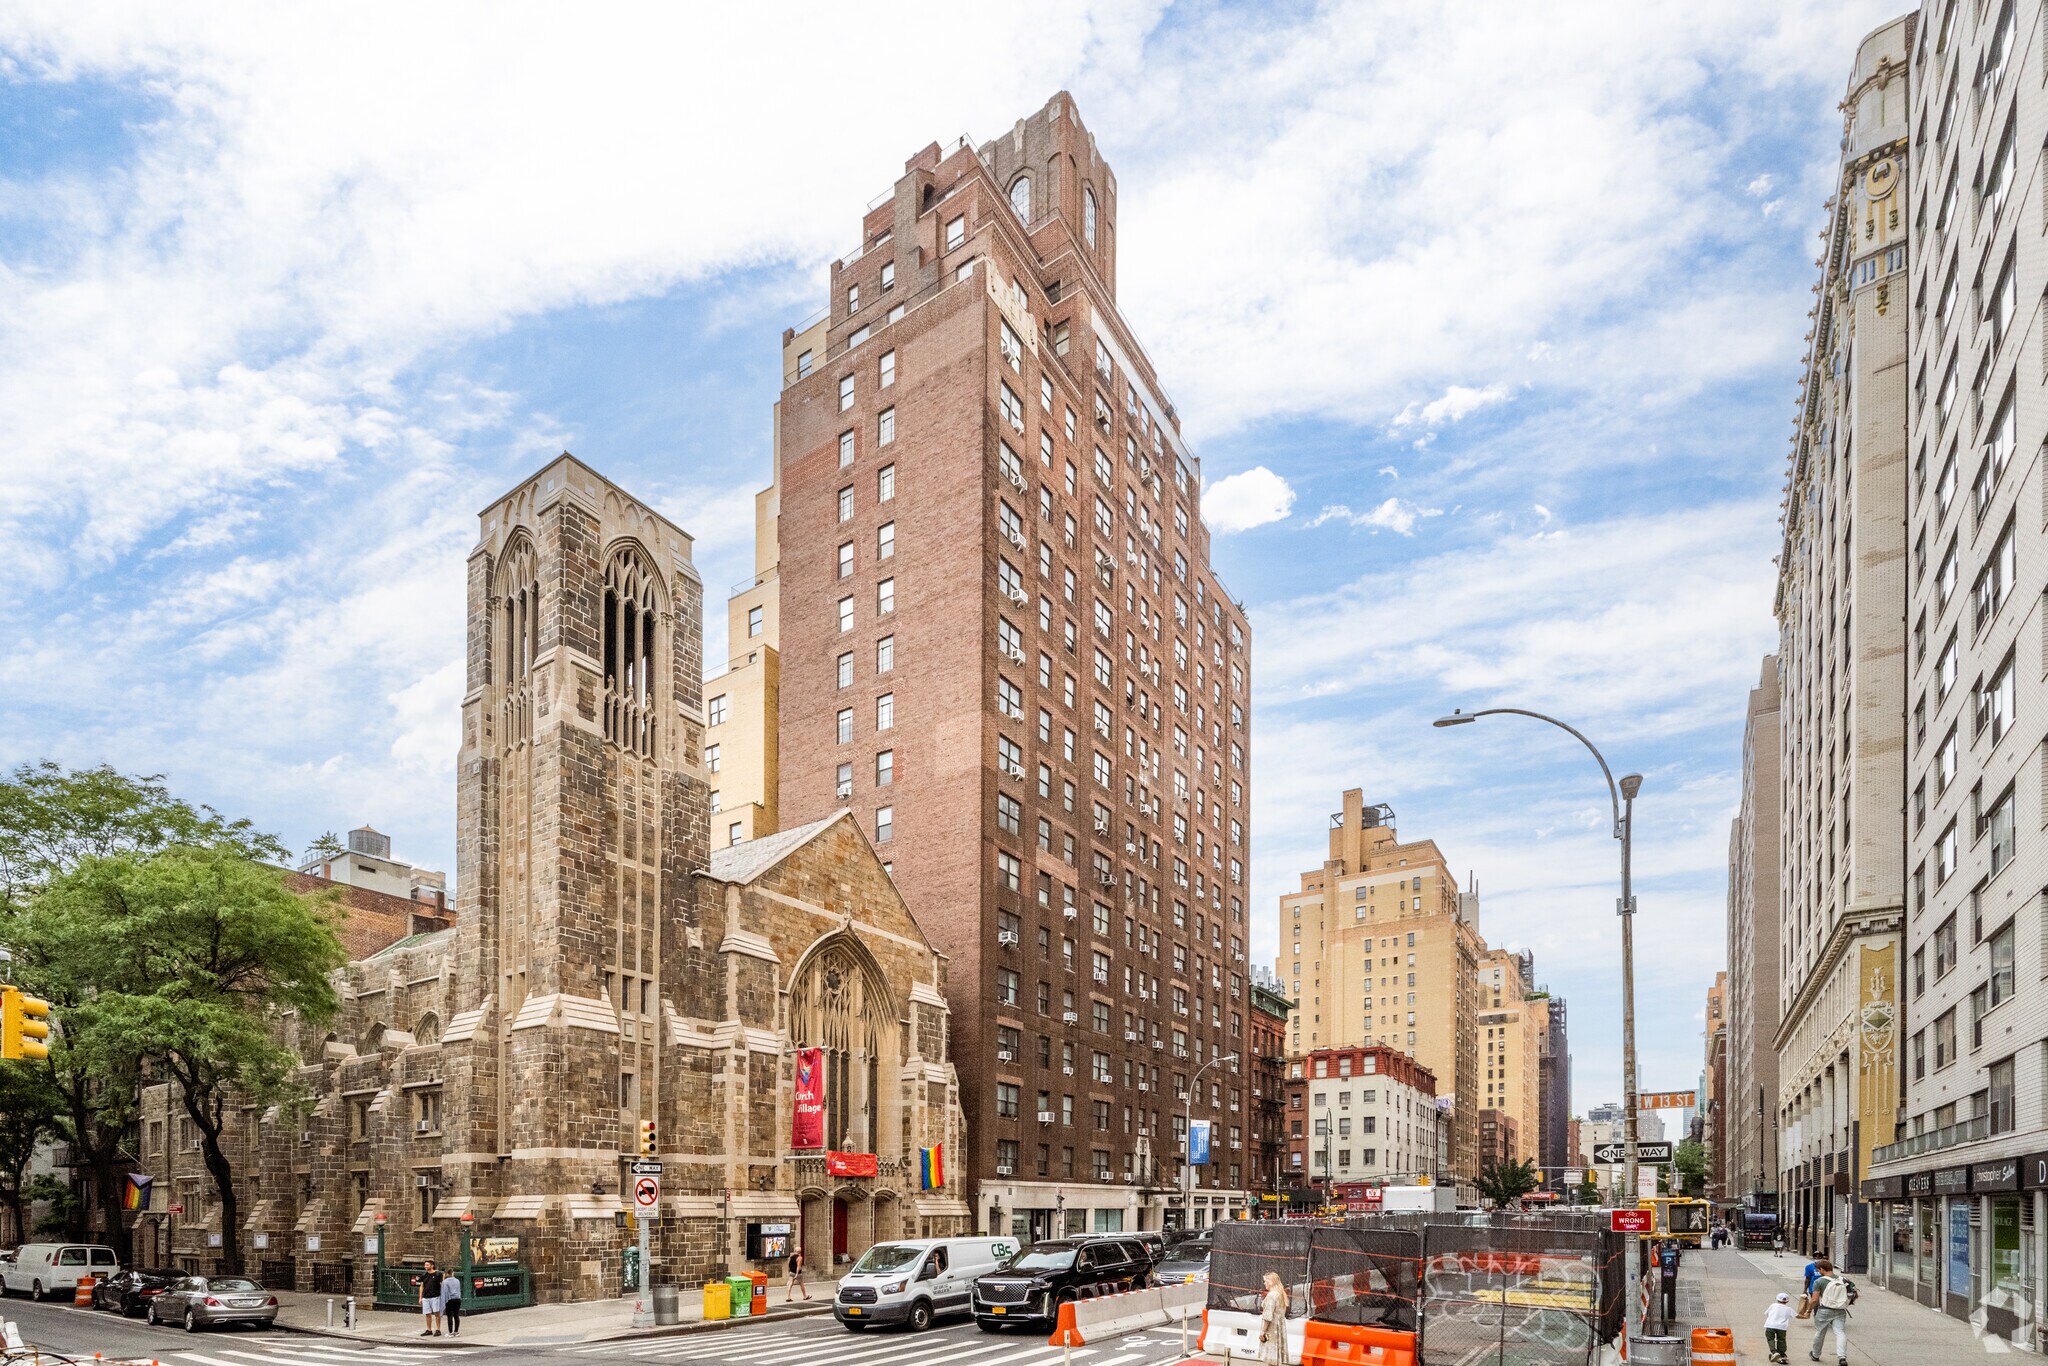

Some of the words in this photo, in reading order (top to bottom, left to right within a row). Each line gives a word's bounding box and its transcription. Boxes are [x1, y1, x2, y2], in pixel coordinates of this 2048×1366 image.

[1644, 1096, 1654, 1109] W
[1659, 1095, 1671, 1108] 13
[1676, 1093, 1690, 1107] ST
[1601, 1149, 1625, 1159] ONE
[1640, 1147, 1665, 1157] WAY
[1349, 1203, 1379, 1211] PIZZA
[1665, 1257, 1672, 1265] P
